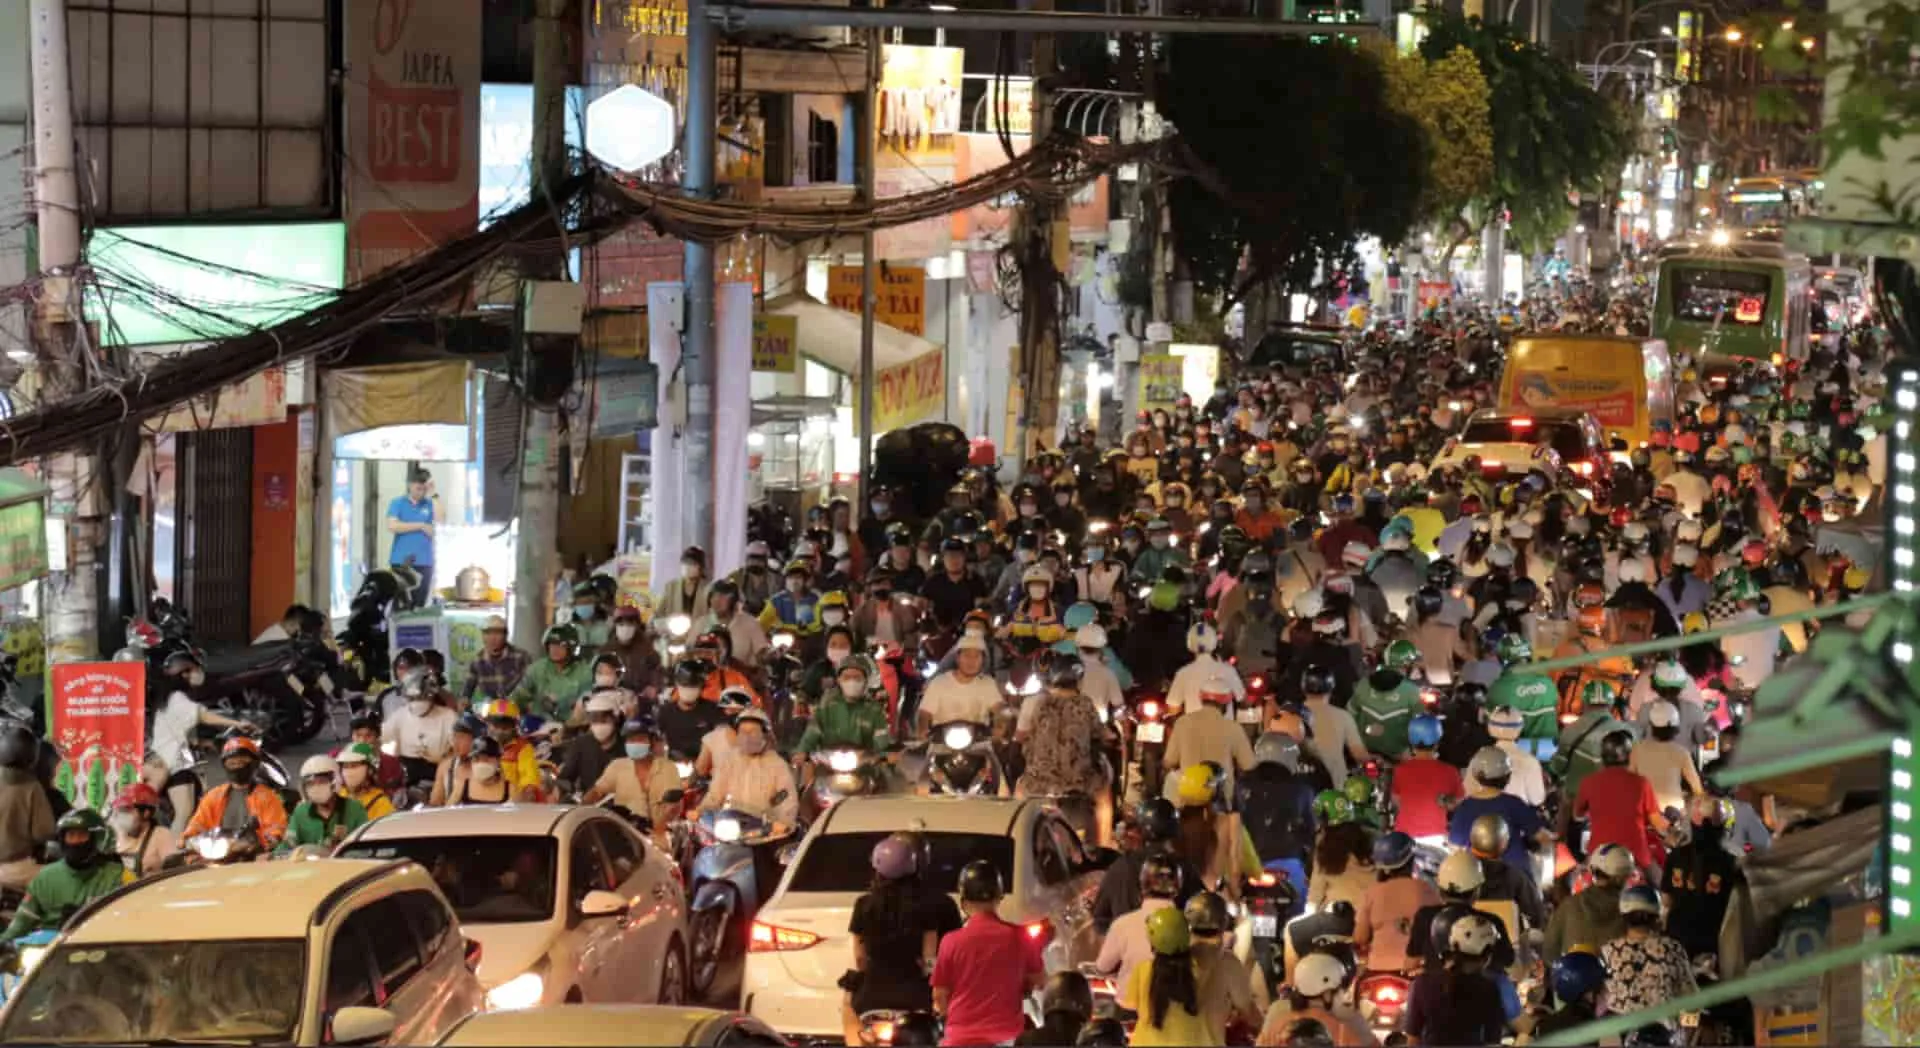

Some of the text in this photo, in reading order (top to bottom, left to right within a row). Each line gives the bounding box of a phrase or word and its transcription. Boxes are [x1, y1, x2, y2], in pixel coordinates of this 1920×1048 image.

[402, 51, 454, 84] JAPFA
[375, 104, 453, 168] BEST
[1516, 682, 1547, 698] Grab
